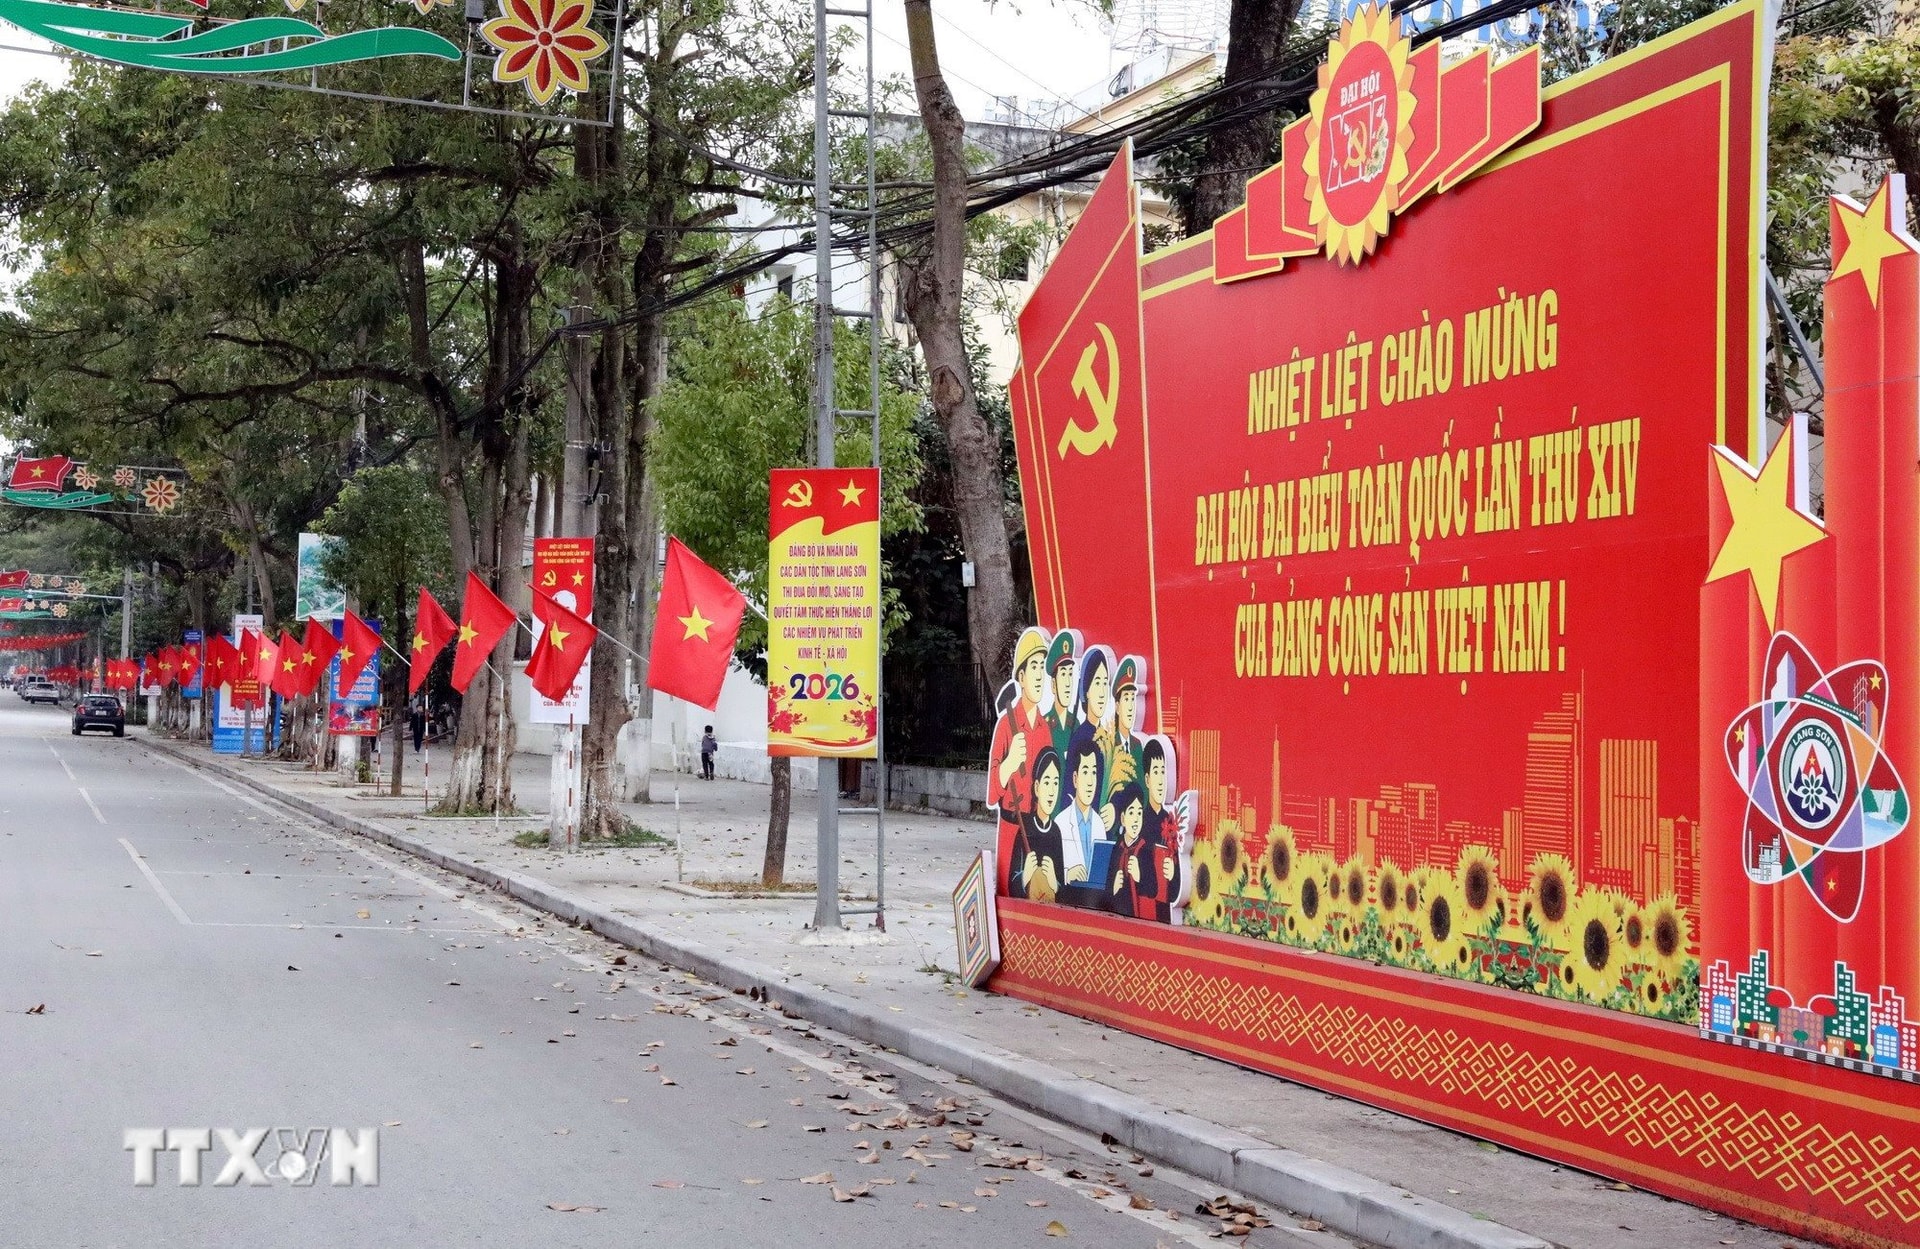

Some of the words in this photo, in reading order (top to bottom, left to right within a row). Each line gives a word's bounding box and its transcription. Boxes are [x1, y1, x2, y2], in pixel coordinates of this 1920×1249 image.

[1340, 81, 1358, 107] ĐẠI
[1360, 70, 1381, 98] HỘI
[1247, 346, 1315, 442] NHIỆT
[1320, 330, 1373, 430] LIỆT
[1379, 309, 1454, 407] CHÀO
[1463, 286, 1558, 388] MỪNG
[1195, 491, 1225, 582] ĐẠI
[1227, 469, 1259, 579] HỘI
[1262, 480, 1294, 575] ĐẠI
[1297, 440, 1343, 554] BIỂU
[1347, 444, 1403, 548] TOÀN
[1408, 419, 1469, 565] QUỐC
[1474, 406, 1522, 534] LẦN
[1529, 406, 1582, 527] THỨ
[1587, 417, 1641, 520] XIV
[789, 542, 806, 557] ĐẢNG
[807, 543, 816, 560] BỘ
[817, 543, 825, 557] VÀ
[826, 543, 844, 557] NHÂN
[845, 543, 858, 557] DÂN
[780, 563, 793, 578] CÁC
[794, 563, 807, 578] DÂN
[808, 564, 820, 580] TỘC
[821, 562, 835, 578] TỈNH
[836, 566, 853, 580] LẠNG
[853, 565, 867, 578] SƠN
[783, 586, 792, 598] THI
[793, 586, 806, 598] ĐUA
[807, 582, 818, 598] ĐỔI
[833, 583, 851, 598] SÁNG
[852, 586, 864, 600] TẠO
[773, 603, 792, 619] QUYẾT
[794, 604, 807, 618] TÂM
[808, 606, 824, 621] THỰC
[825, 604, 840, 621] HIỆN
[841, 603, 862, 618] THẮNG
[862, 606, 873, 621] LỢI
[783, 625, 796, 639] CÁC
[797, 625, 817, 641] NHIỆM
[818, 627, 827, 641] VỤ
[828, 625, 843, 639] PHÁT
[844, 622, 863, 639] TRIỂN
[1234, 582, 1267, 678] CỦA
[1271, 578, 1323, 677] ĐẢNG
[1327, 576, 1383, 696] CỘNG
[1388, 566, 1430, 675] SẢN
[1435, 565, 1488, 696] VIỆT
[798, 648, 813, 659] KINH
[814, 644, 821, 659] TẾ
[827, 645, 835, 659] XÃ
[836, 645, 848, 661] HỘI
[789, 673, 860, 700] 2026
[1792, 727, 1814, 747] LẠNG
